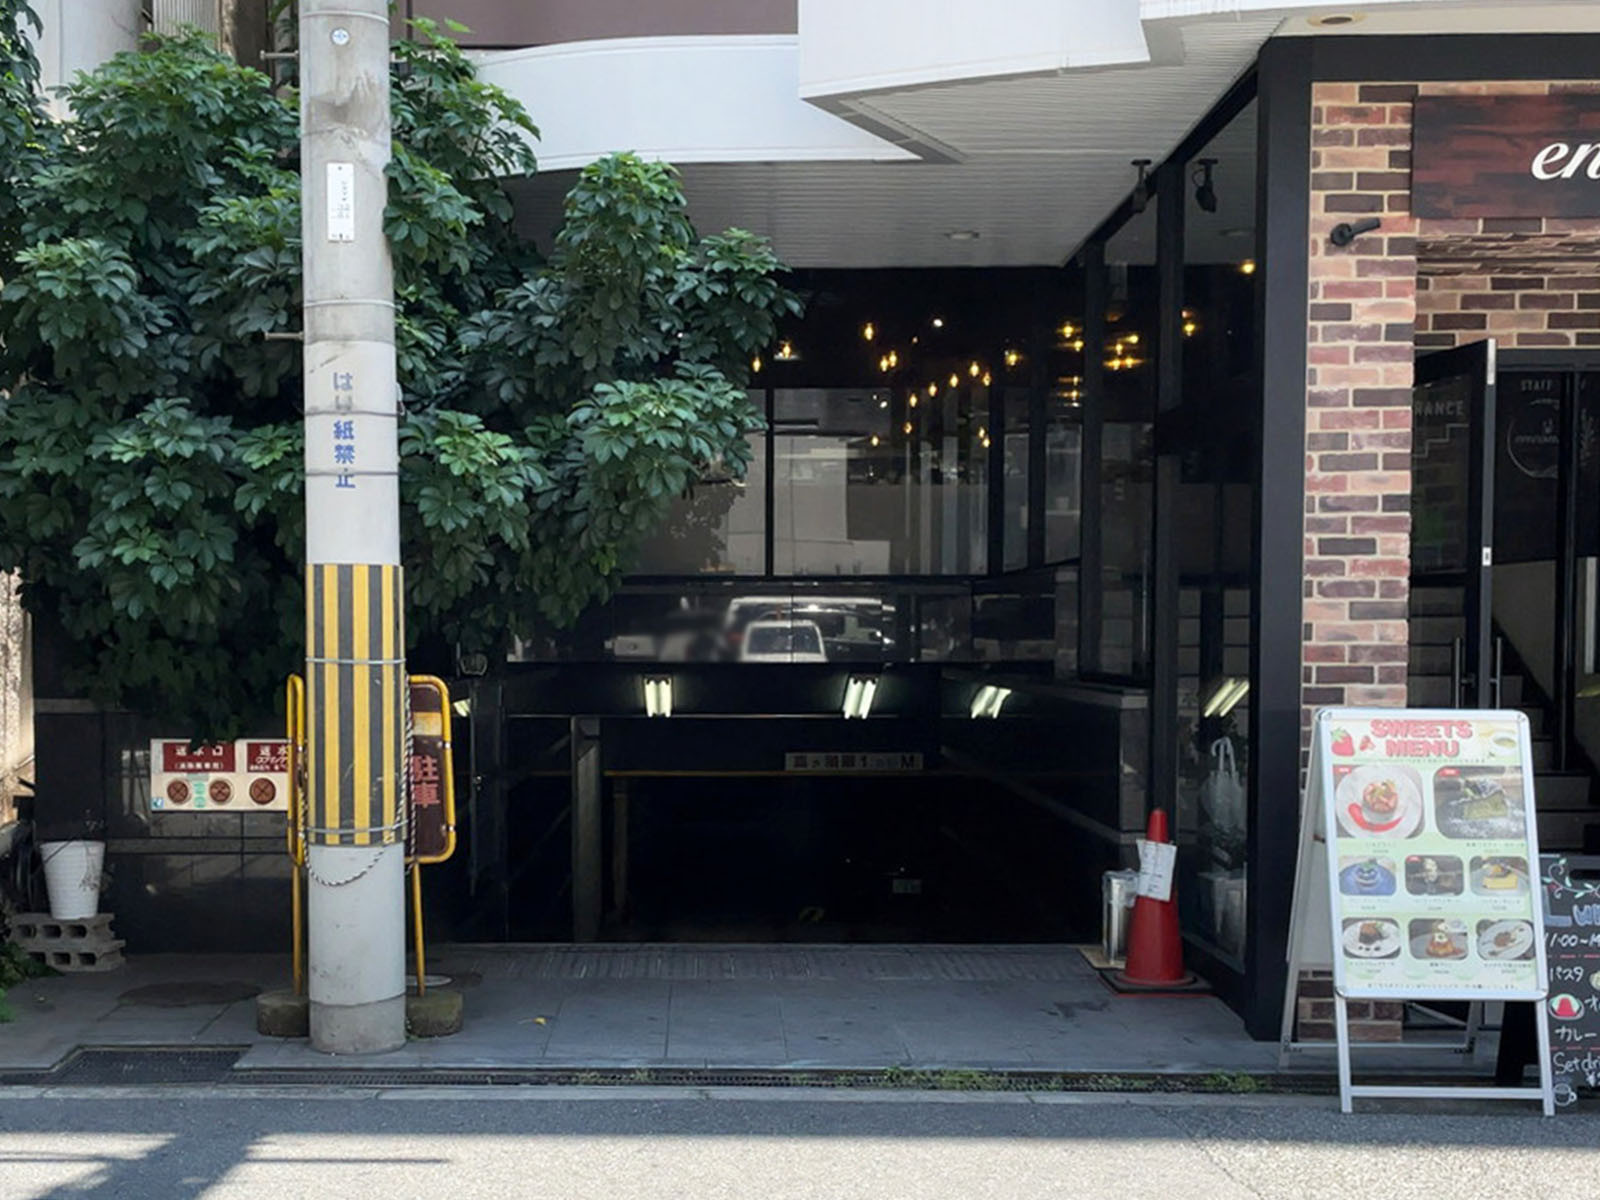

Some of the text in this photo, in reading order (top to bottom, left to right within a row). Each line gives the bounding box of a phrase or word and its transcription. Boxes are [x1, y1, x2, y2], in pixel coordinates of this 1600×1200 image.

[1370, 718, 1474, 738] SWEETS
[1385, 739, 1461, 758] MENU
[1555, 1026, 1598, 1041] カレー
[1552, 1051, 1581, 1075] Set
